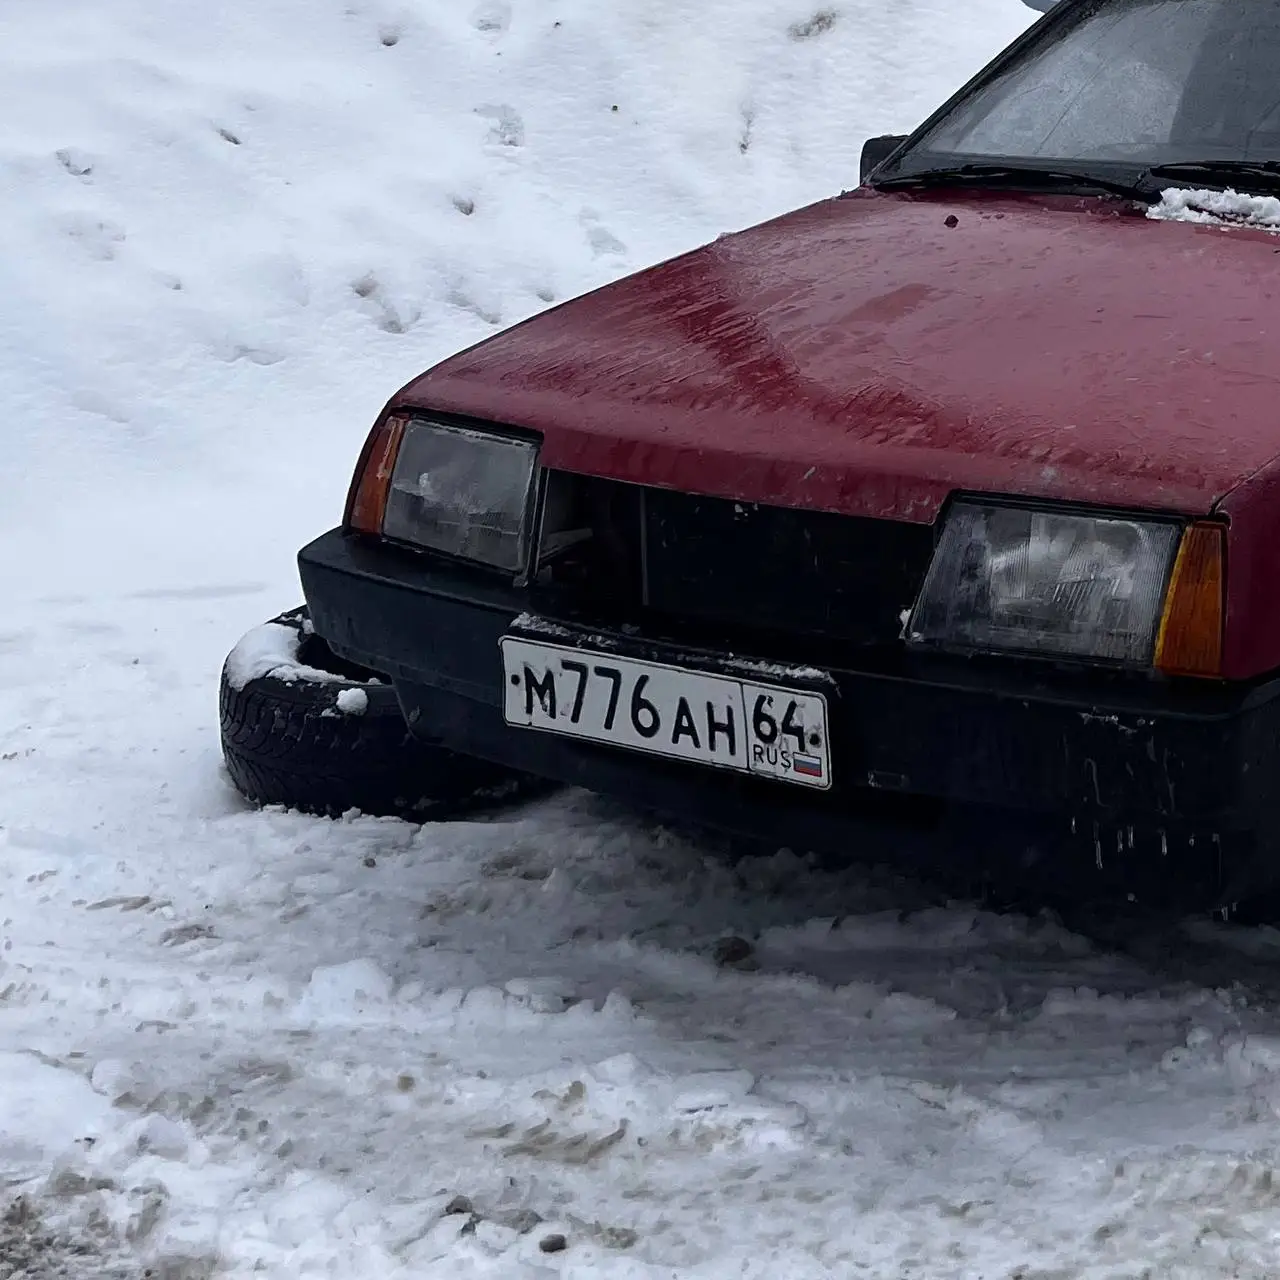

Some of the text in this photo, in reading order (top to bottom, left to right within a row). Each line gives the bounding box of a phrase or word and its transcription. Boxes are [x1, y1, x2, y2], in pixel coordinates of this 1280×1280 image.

[524, 659, 806, 755] М776АН 64
[753, 744, 792, 768] RUS
